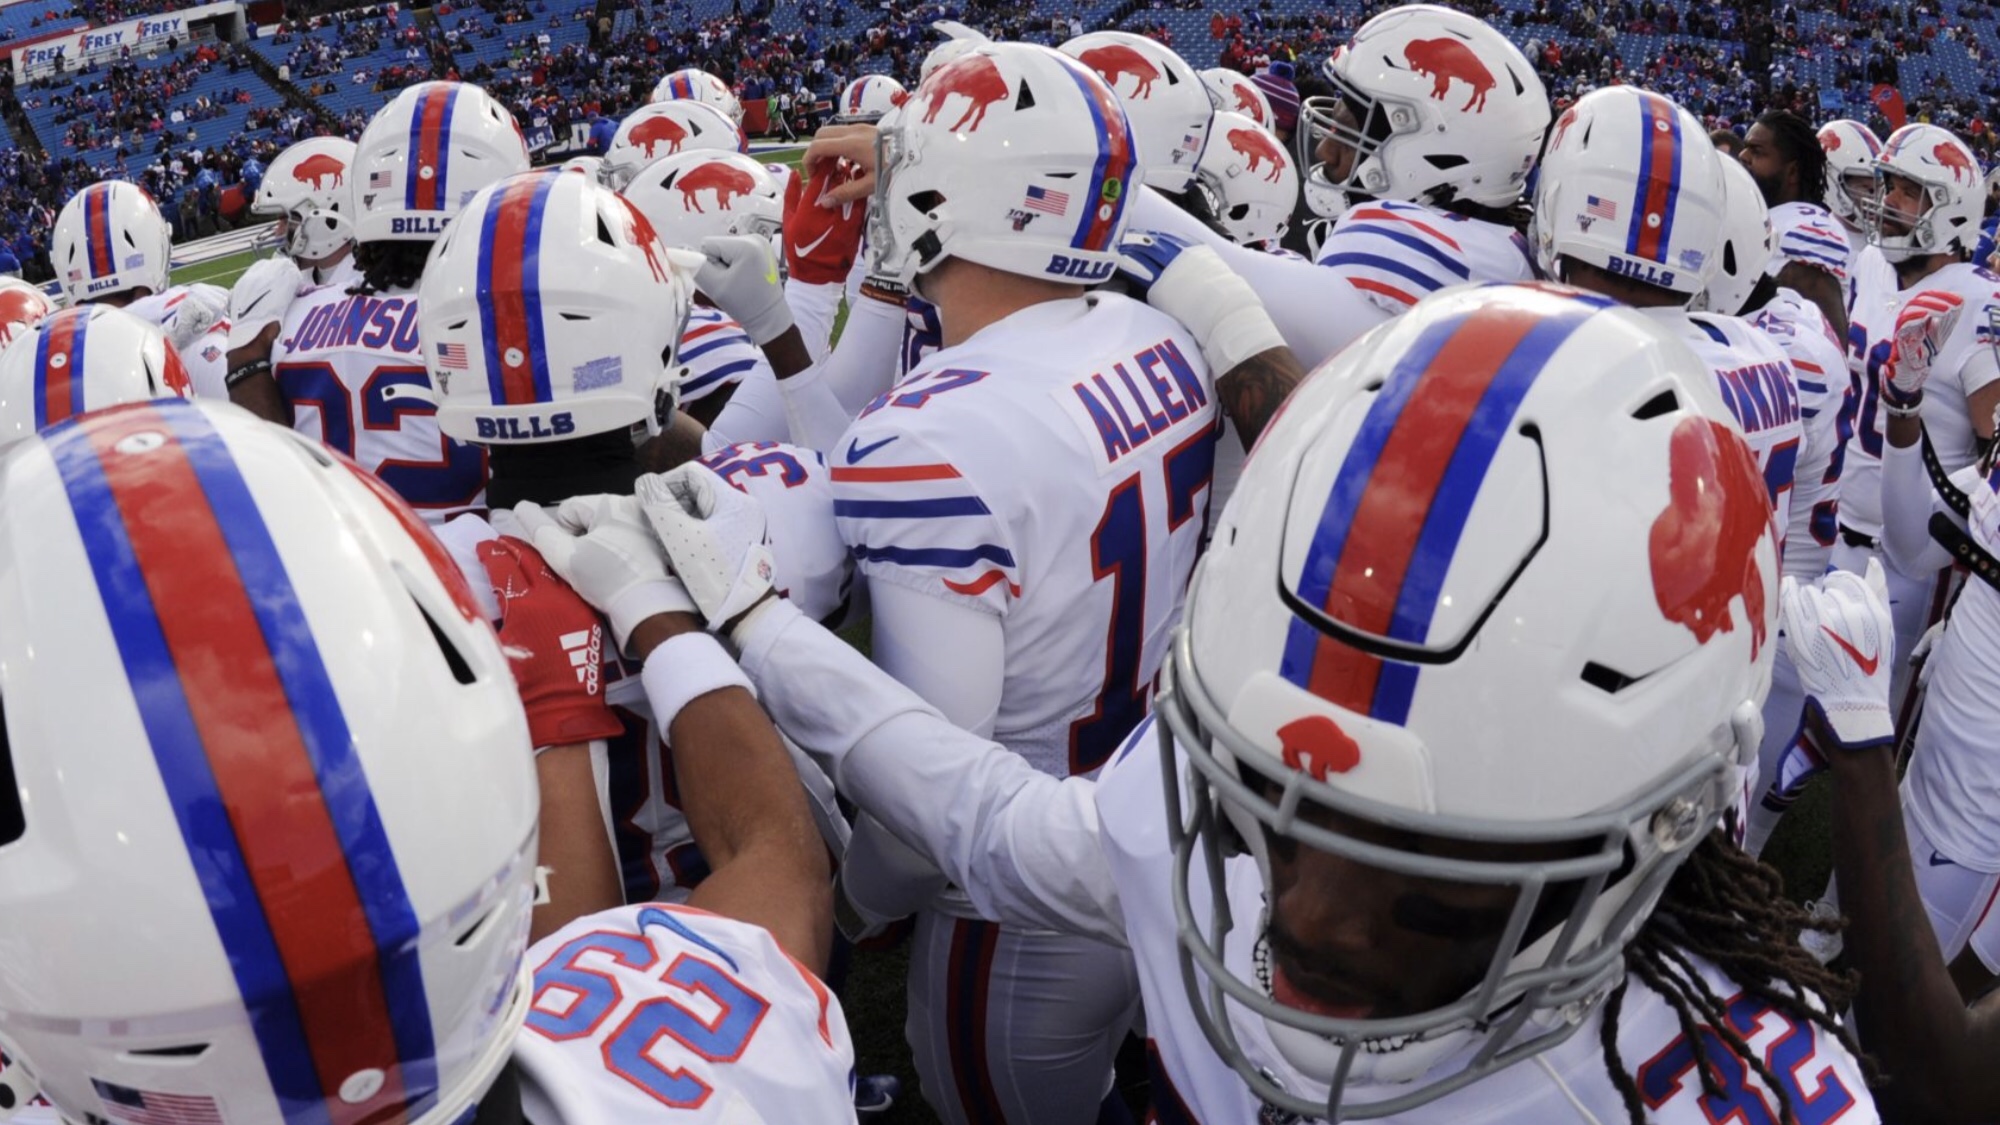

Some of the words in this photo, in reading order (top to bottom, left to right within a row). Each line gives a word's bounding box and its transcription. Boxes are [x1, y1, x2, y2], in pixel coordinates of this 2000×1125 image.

[28, 45, 66, 65] FREY
[85, 31, 123, 50] FREY
[142, 18, 180, 37] FREY
[87, 278, 119, 293] BILLS
[1045, 254, 1115, 279] BILLS
[1606, 255, 1675, 287] BILLS
[283, 295, 423, 353] JOHNSO
[858, 368, 992, 421] 17
[1072, 338, 1208, 464] ALLEN
[475, 411, 576, 440] BILLS
[1068, 419, 1217, 776] 17
[586, 623, 602, 696] adidas
[523, 929, 772, 1111] 62
[1637, 985, 1857, 1125] 32
